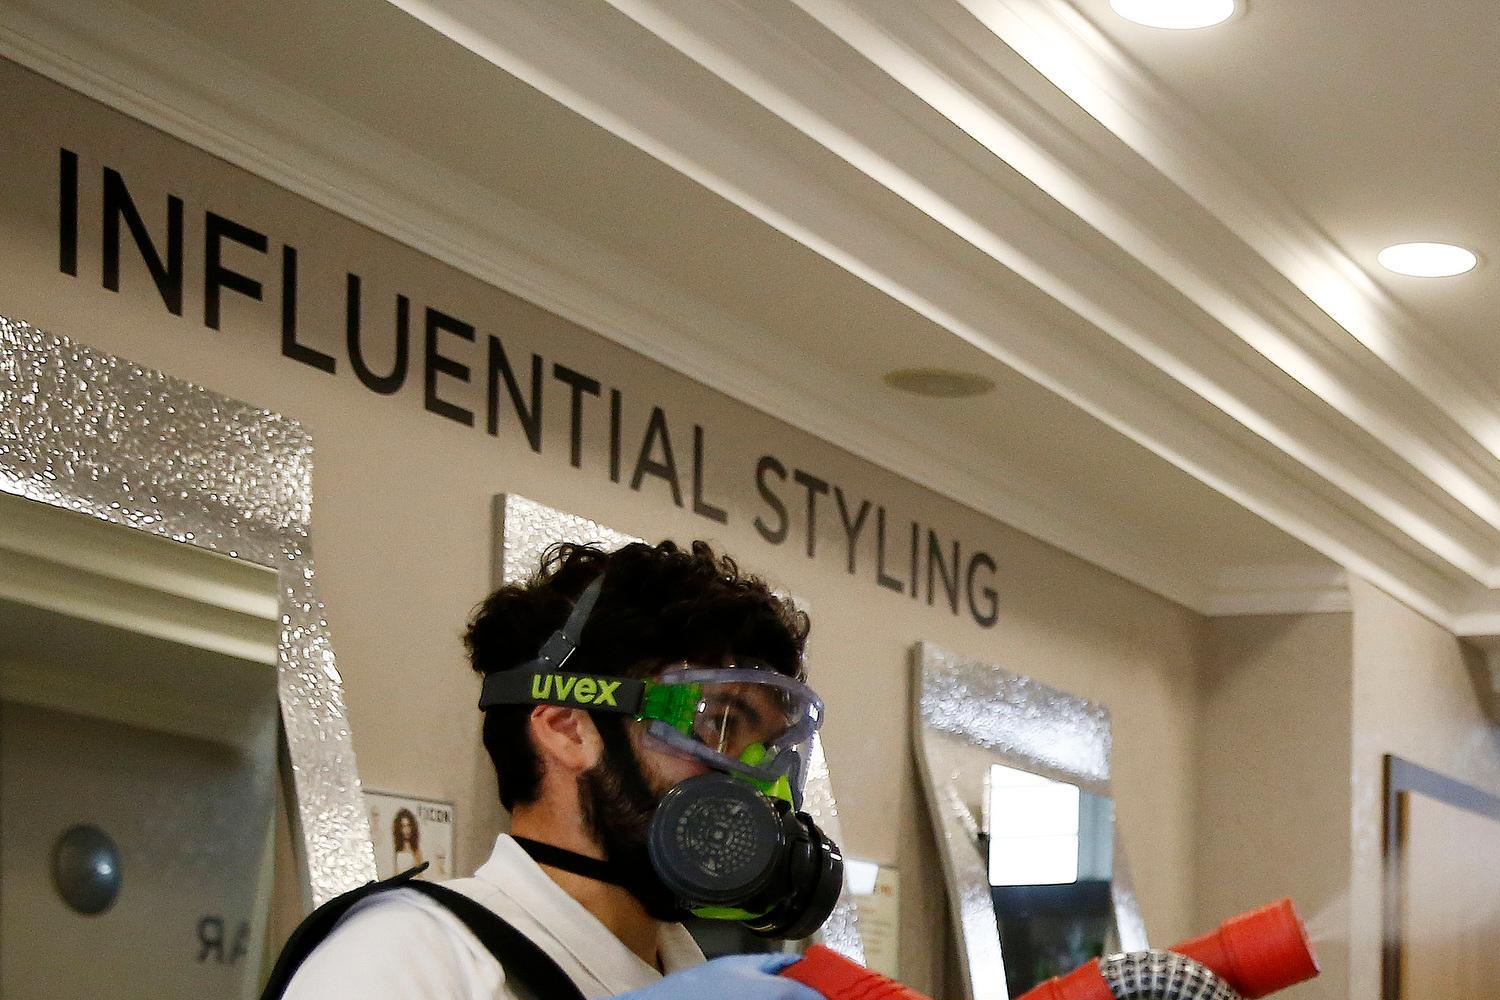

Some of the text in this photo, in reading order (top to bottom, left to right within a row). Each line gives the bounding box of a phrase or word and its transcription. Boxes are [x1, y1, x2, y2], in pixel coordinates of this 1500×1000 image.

[59, 147, 999, 627] INFLUENTIAL STYLING
[531, 674, 622, 706] uvex
